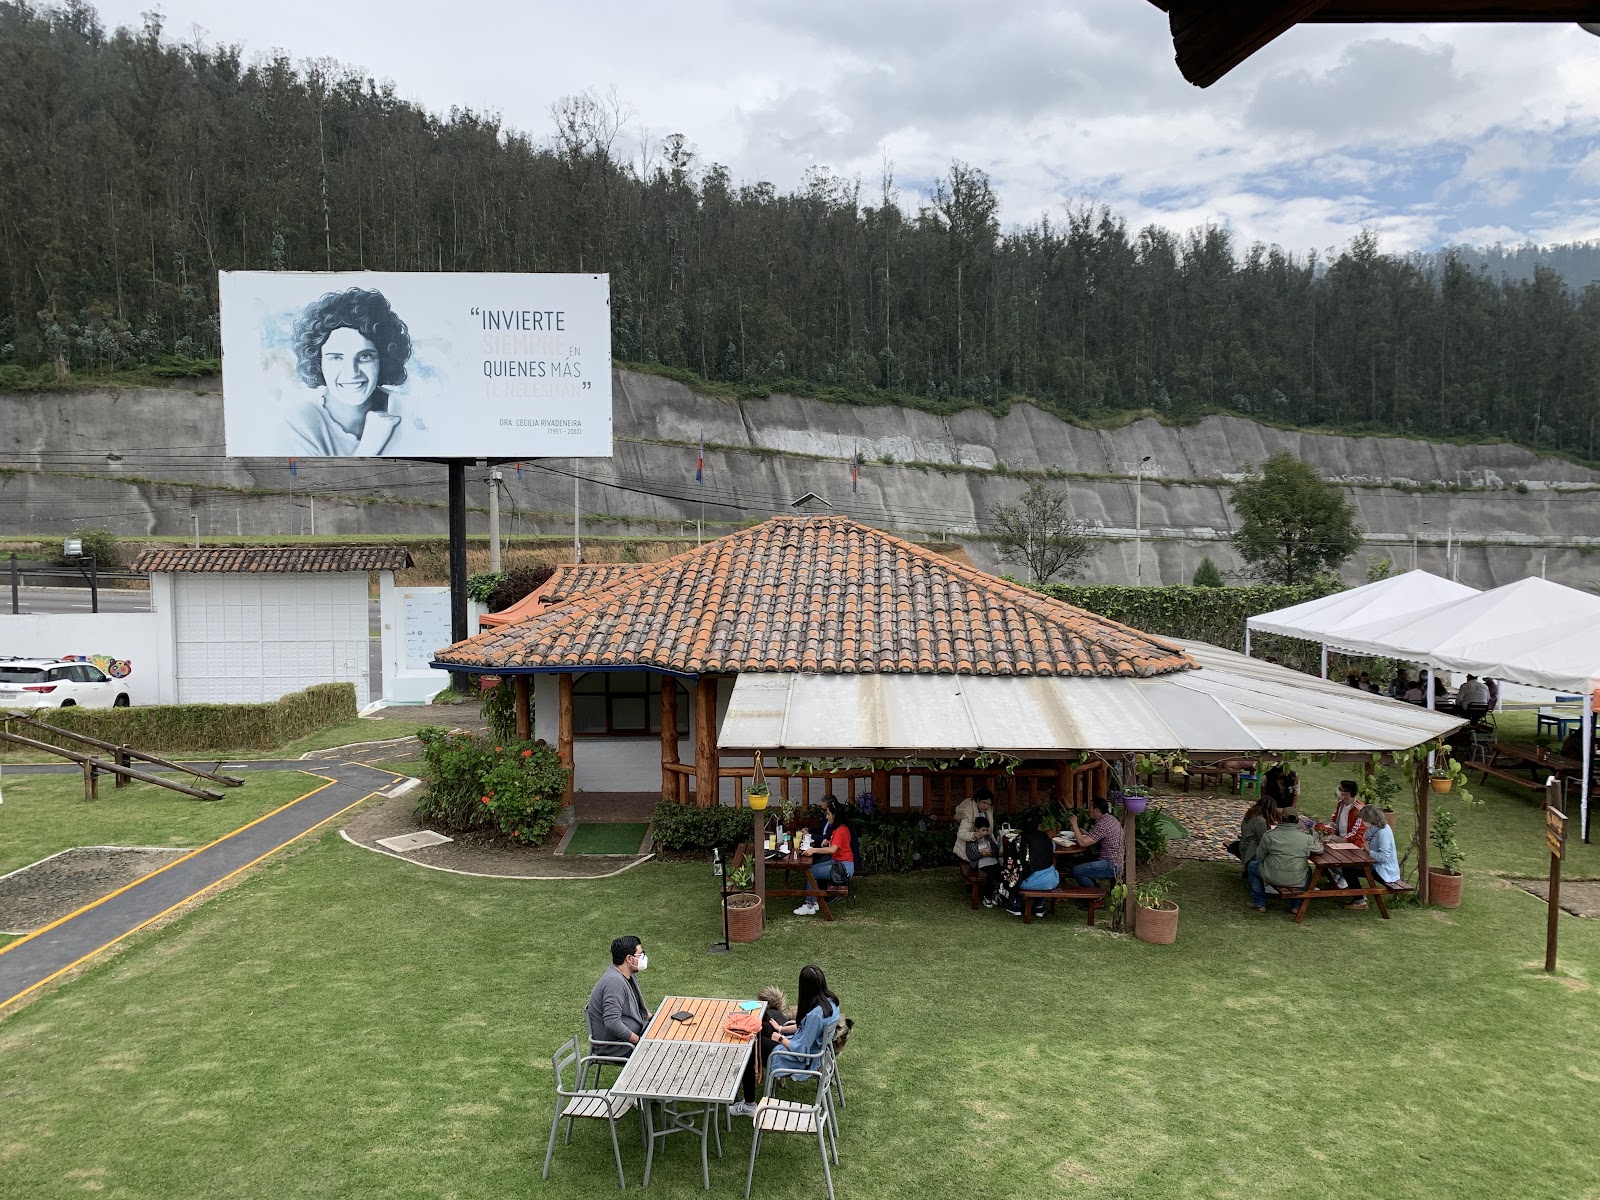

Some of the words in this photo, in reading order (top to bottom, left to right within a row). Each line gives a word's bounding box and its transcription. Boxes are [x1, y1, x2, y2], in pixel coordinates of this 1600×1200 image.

[483, 333, 565, 357] SIEMPRE
[569, 346, 581, 357] EN
[483, 360, 546, 379] QUIENES
[551, 356, 581, 378] MÁS
[499, 418, 514, 427] DRA.
[516, 419, 540, 427] CECILIA
[541, 419, 582, 427] RIVADENEIRA
